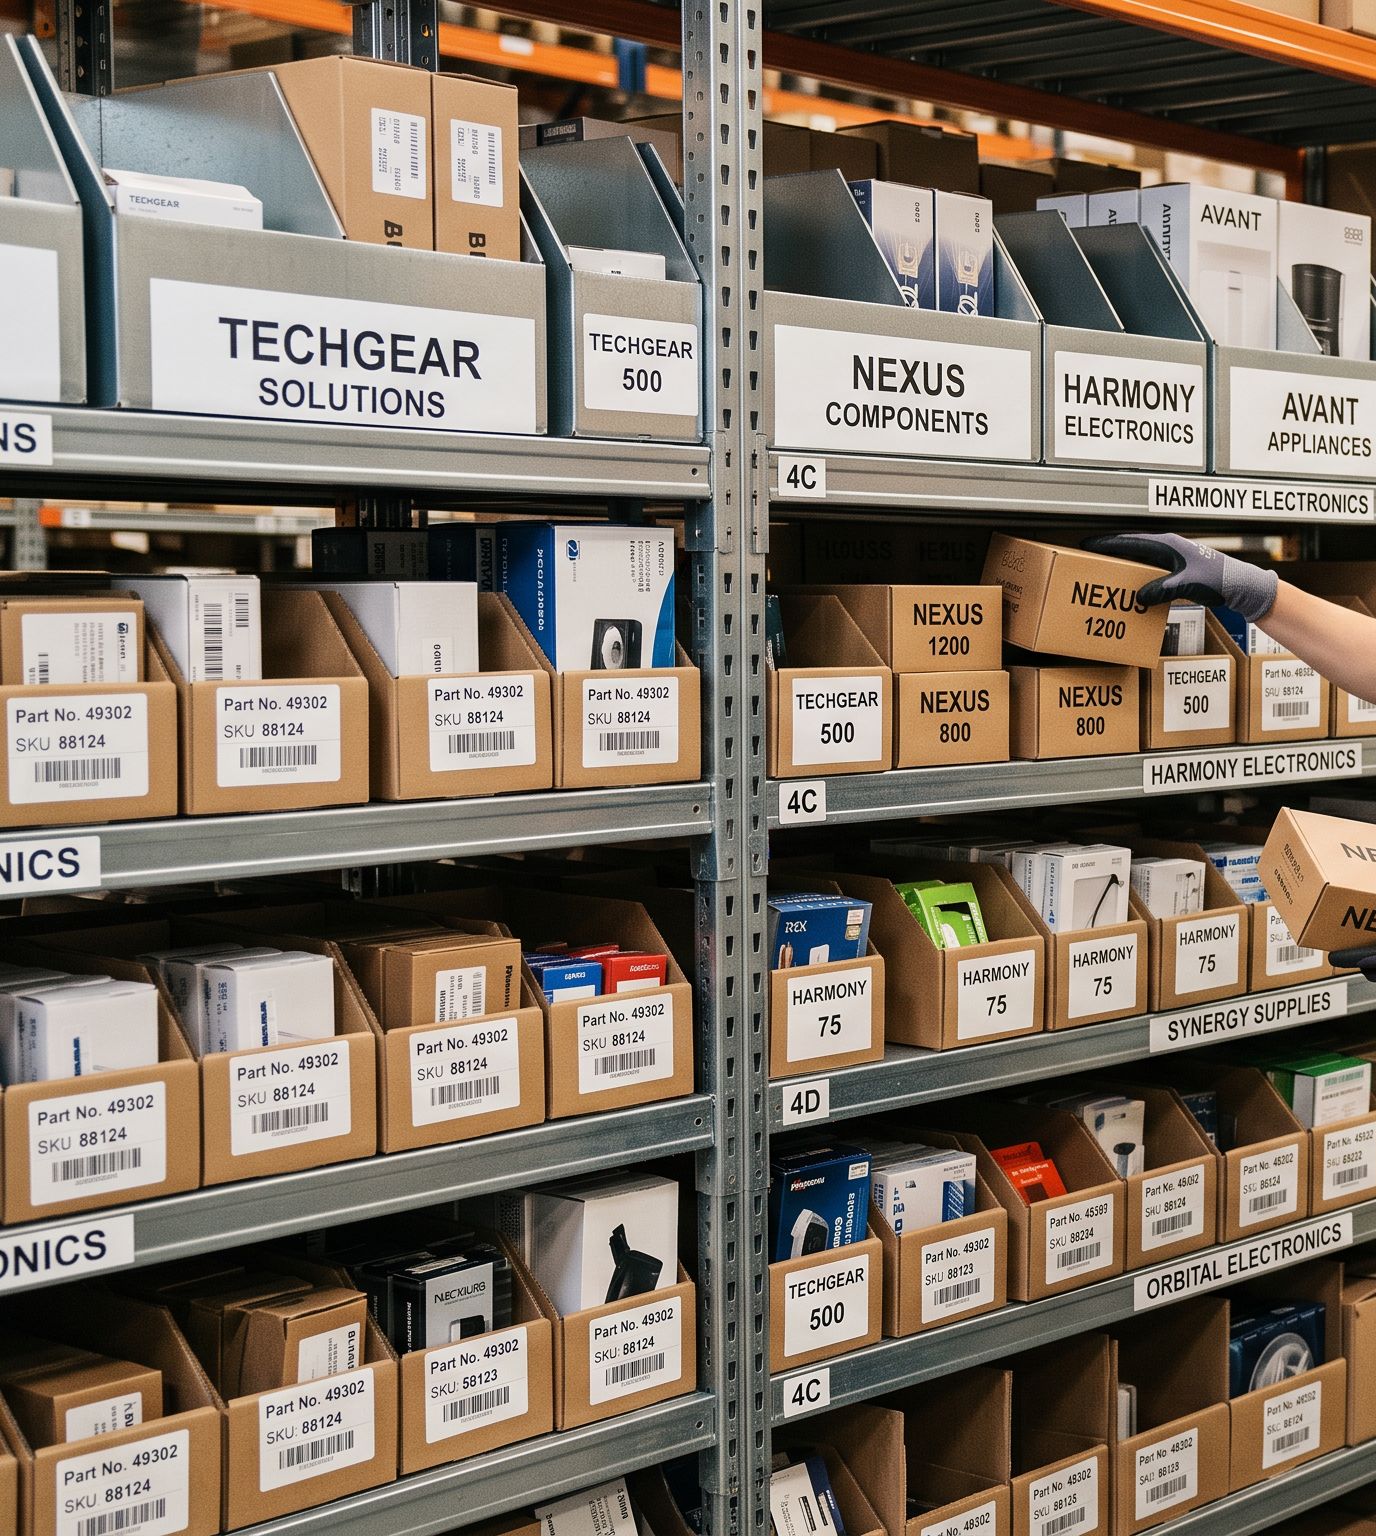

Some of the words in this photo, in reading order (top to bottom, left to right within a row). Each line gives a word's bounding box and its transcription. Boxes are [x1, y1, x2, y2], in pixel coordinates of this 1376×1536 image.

[129, 195, 179, 208] TECHGEAR
[1201, 204, 1261, 231] AVANT
[219, 317, 482, 380] TECHGEAR
[589, 333, 693, 359] TECHGEAR
[623, 368, 662, 392] 500
[853, 355, 964, 398] NEXUS
[259, 378, 445, 418] SOLUTIONS
[1065, 373, 1195, 413] HARMONY
[826, 402, 988, 435] COMPONENTS
[1282, 392, 1359, 425] AVANT
[1065, 415, 1193, 444] ELECTRONICS
[1268, 432, 1371, 457] APPLIANCES
[787, 464, 816, 489] 4C
[1156, 485, 1247, 509] HARMONY
[1253, 490, 1368, 514] ELECTRONICS
[1071, 581, 1149, 614] NEXUS
[914, 603, 983, 625] NEXUS
[1085, 617, 1126, 639] 1200
[929, 636, 969, 656] 1200
[1167, 669, 1226, 685] TECHGEAR
[1265, 669, 1279, 678] Part
[225, 698, 254, 711] Part
[259, 698, 281, 710] No.
[286, 696, 327, 709] 49302
[435, 689, 460, 701] Part
[464, 688, 484, 699] No.
[488, 685, 523, 698] 49302
[589, 689, 612, 700] Part
[615, 688, 633, 700] No.
[637, 687, 669, 699] 49302
[796, 691, 878, 710] TECHGEAR
[921, 689, 989, 714] NEXUS
[1059, 684, 1122, 708] NEXUS
[1184, 695, 1209, 714] 500
[16, 710, 49, 723] Part
[55, 708, 80, 721] No.
[86, 705, 131, 720] 49302
[435, 713, 461, 727] SKU
[467, 710, 503, 724] 88124
[588, 713, 612, 725] SKU
[618, 711, 650, 723] 88124
[1077, 716, 1105, 736] 800
[224, 725, 254, 738] SKU
[262, 723, 304, 736] 88124
[821, 722, 854, 744] 500
[940, 722, 971, 743] 800
[16, 737, 50, 752] SKU
[59, 734, 106, 749] 88124
[1152, 758, 1241, 787] HARMONY
[1244, 749, 1355, 777] ELECTRONICS
[787, 789, 817, 814] 4C
[1180, 924, 1235, 946] HARMONY
[1073, 945, 1133, 968] HARMONY
[1199, 954, 1215, 973] 75
[964, 962, 1029, 986] HARMONY
[1094, 976, 1112, 996] 75
[793, 980, 867, 1006] HARMONY
[987, 994, 1006, 1016] 75
[583, 1014, 606, 1027] Part
[610, 1011, 628, 1023] No.
[631, 1003, 664, 1019] 49302
[818, 1014, 841, 1037] 75
[1168, 1006, 1249, 1041] SYNERGY
[1254, 992, 1330, 1024] SUPPLIES
[417, 1041, 443, 1056] Part
[447, 1038, 468, 1051] No.
[472, 1029, 508, 1046] 49302
[583, 1037, 606, 1051] SKU
[612, 1030, 645, 1046] 88124
[238, 1065, 266, 1081] Part
[271, 1062, 293, 1075] No.
[298, 1053, 338, 1070] 49302
[417, 1066, 443, 1081] SKU
[451, 1057, 487, 1075] 88124
[238, 1091, 266, 1108] SKU
[273, 1082, 315, 1102] 88124
[791, 1089, 820, 1115] 4D
[38, 1110, 70, 1126] Part
[76, 1106, 101, 1119] No.
[107, 1095, 153, 1114] 49302
[38, 1137, 71, 1154] SKU
[79, 1127, 127, 1147] 88124
[1244, 1164, 1257, 1175] Part
[1146, 1185, 1161, 1197] Part
[1050, 1216, 1067, 1228] Part
[1068, 1211, 1082, 1224] No.
[1070, 1227, 1094, 1243] 88234
[926, 1251, 943, 1264] Part
[946, 1248, 960, 1259] No.
[963, 1238, 989, 1253] 49302
[1147, 1260, 1222, 1299] ORBITAL
[1227, 1222, 1341, 1275] ELECTRONICS
[789, 1266, 864, 1299] TECHGEAR
[948, 1263, 973, 1279] 88123
[595, 1324, 617, 1340] Part
[621, 1320, 638, 1333] No.
[642, 1308, 673, 1326] 49302
[810, 1302, 844, 1330] 500
[431, 1358, 456, 1374] Part
[460, 1353, 480, 1366] No.
[483, 1339, 519, 1359] 49302
[595, 1347, 620, 1363] SKU:
[623, 1336, 655, 1355] 88124
[431, 1381, 458, 1399] SKU:
[463, 1369, 497, 1389] 58123
[792, 1379, 820, 1406] 4C
[266, 1401, 294, 1419] Part
[299, 1396, 320, 1410] No.
[325, 1380, 364, 1401] 49302
[267, 1426, 296, 1444] SKU:
[302, 1411, 342, 1434] 88124
[65, 1467, 96, 1486] Part
[102, 1461, 126, 1476] No.
[132, 1444, 177, 1467] 49302
[1139, 1453, 1154, 1466] Part
[105, 1479, 151, 1502] 88124
[1034, 1486, 1050, 1500] Part
[946, 1527, 961, 1536] No.
[963, 1512, 990, 1531] 48302
